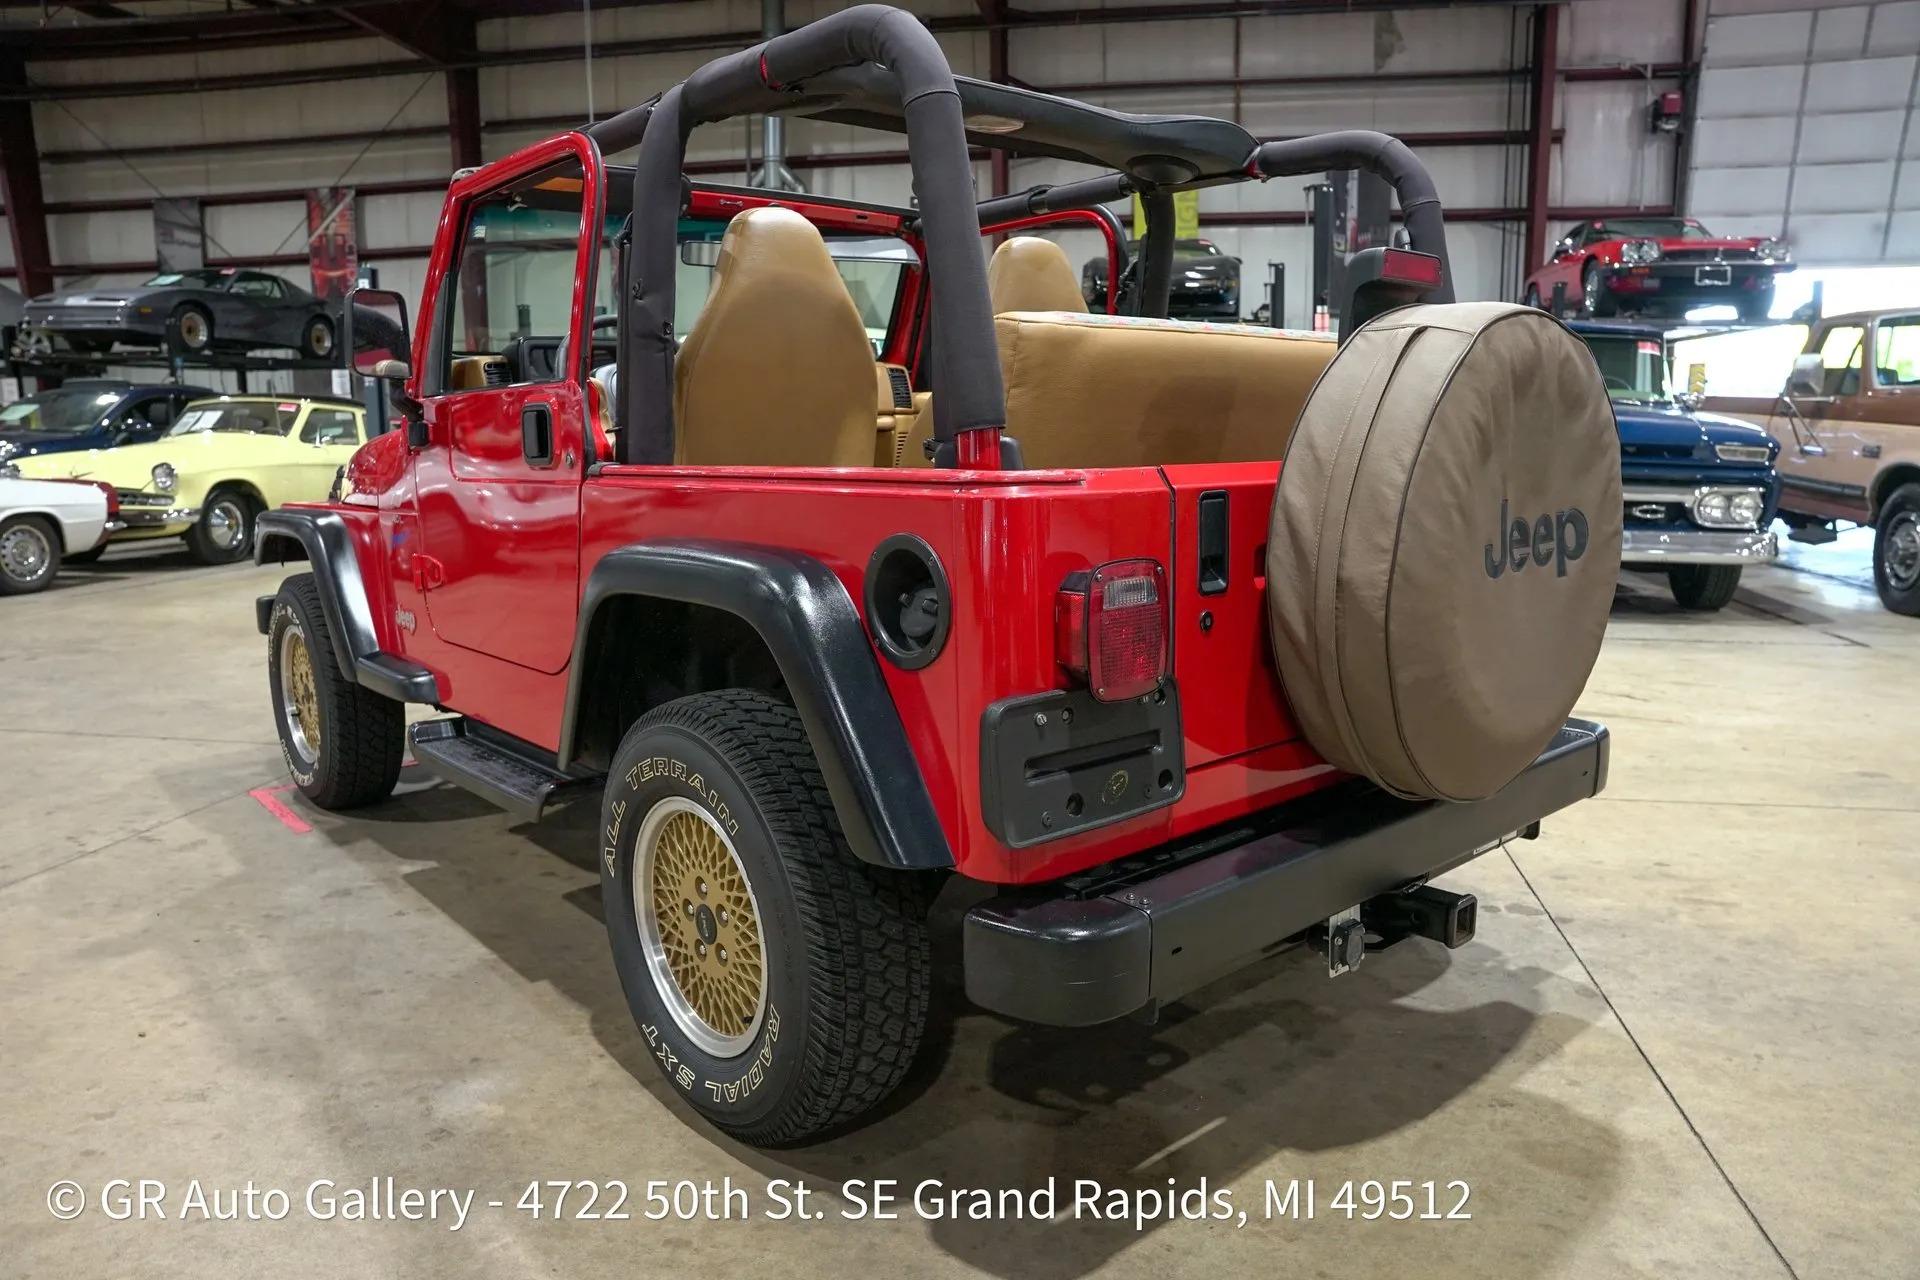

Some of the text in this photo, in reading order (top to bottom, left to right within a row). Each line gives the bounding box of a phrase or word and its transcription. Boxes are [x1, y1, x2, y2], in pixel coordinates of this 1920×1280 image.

[1485, 498, 1589, 579] Jeep
[604, 757, 739, 878] ALL TERRAIN
[641, 1003, 781, 1103] RADIAL SXT
